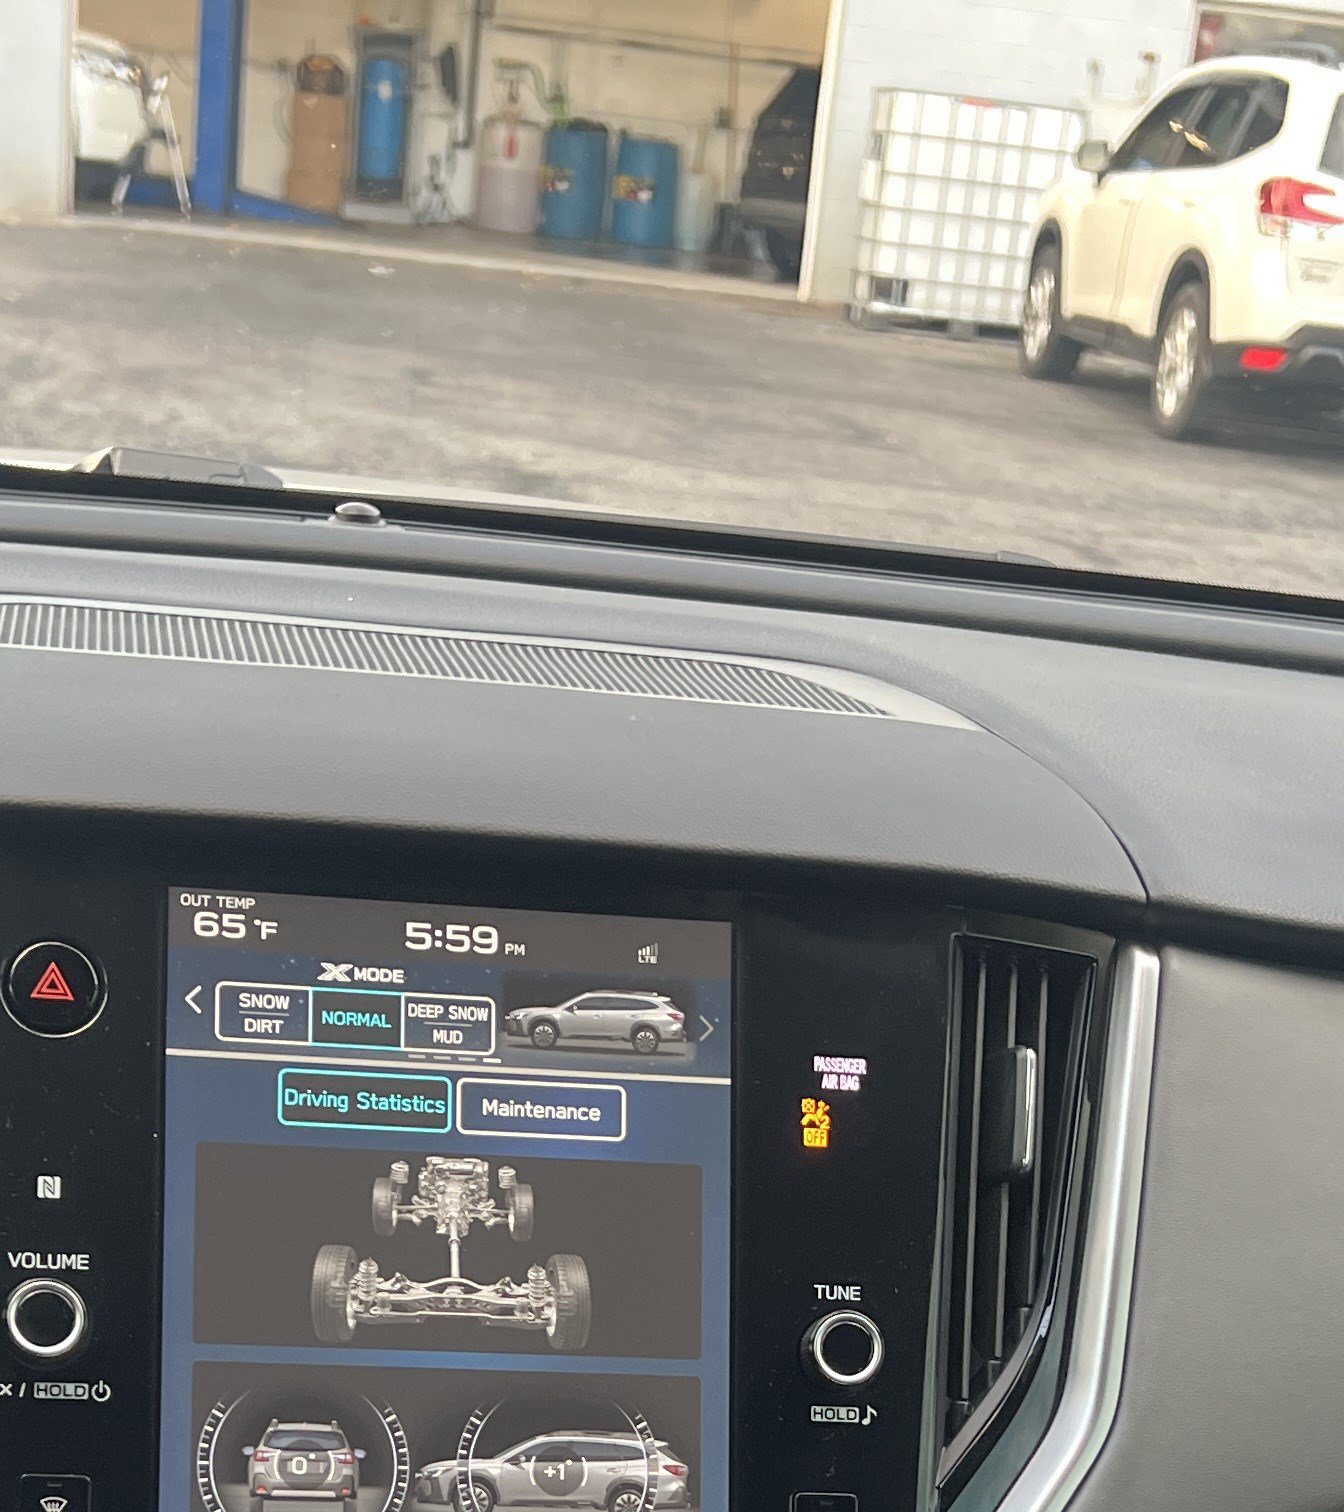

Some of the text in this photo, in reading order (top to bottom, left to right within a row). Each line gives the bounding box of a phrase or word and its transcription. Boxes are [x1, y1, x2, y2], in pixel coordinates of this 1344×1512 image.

[180, 892, 257, 910] OUT TEMP
[193, 911, 246, 939] 65
[405, 921, 526, 957] 5:59 PM
[239, 993, 290, 1011] SNOW
[322, 1011, 392, 1029] NORMAL
[408, 1003, 489, 1022] DEEP SNOW
[244, 1018, 285, 1035] DIRT
[432, 1029, 464, 1045] MUD
[813, 1055, 868, 1075] PASSENGER
[821, 1074, 861, 1091] AIR BAG
[284, 1088, 447, 1115] Driving Statistics
[482, 1098, 602, 1122] Maintenance
[805, 1129, 827, 1147] OFF
[8, 1251, 91, 1270] VOLUME
[813, 1284, 862, 1302] TUNE
[36, 1383, 87, 1398] HOLD
[812, 1406, 858, 1422] HOLD
